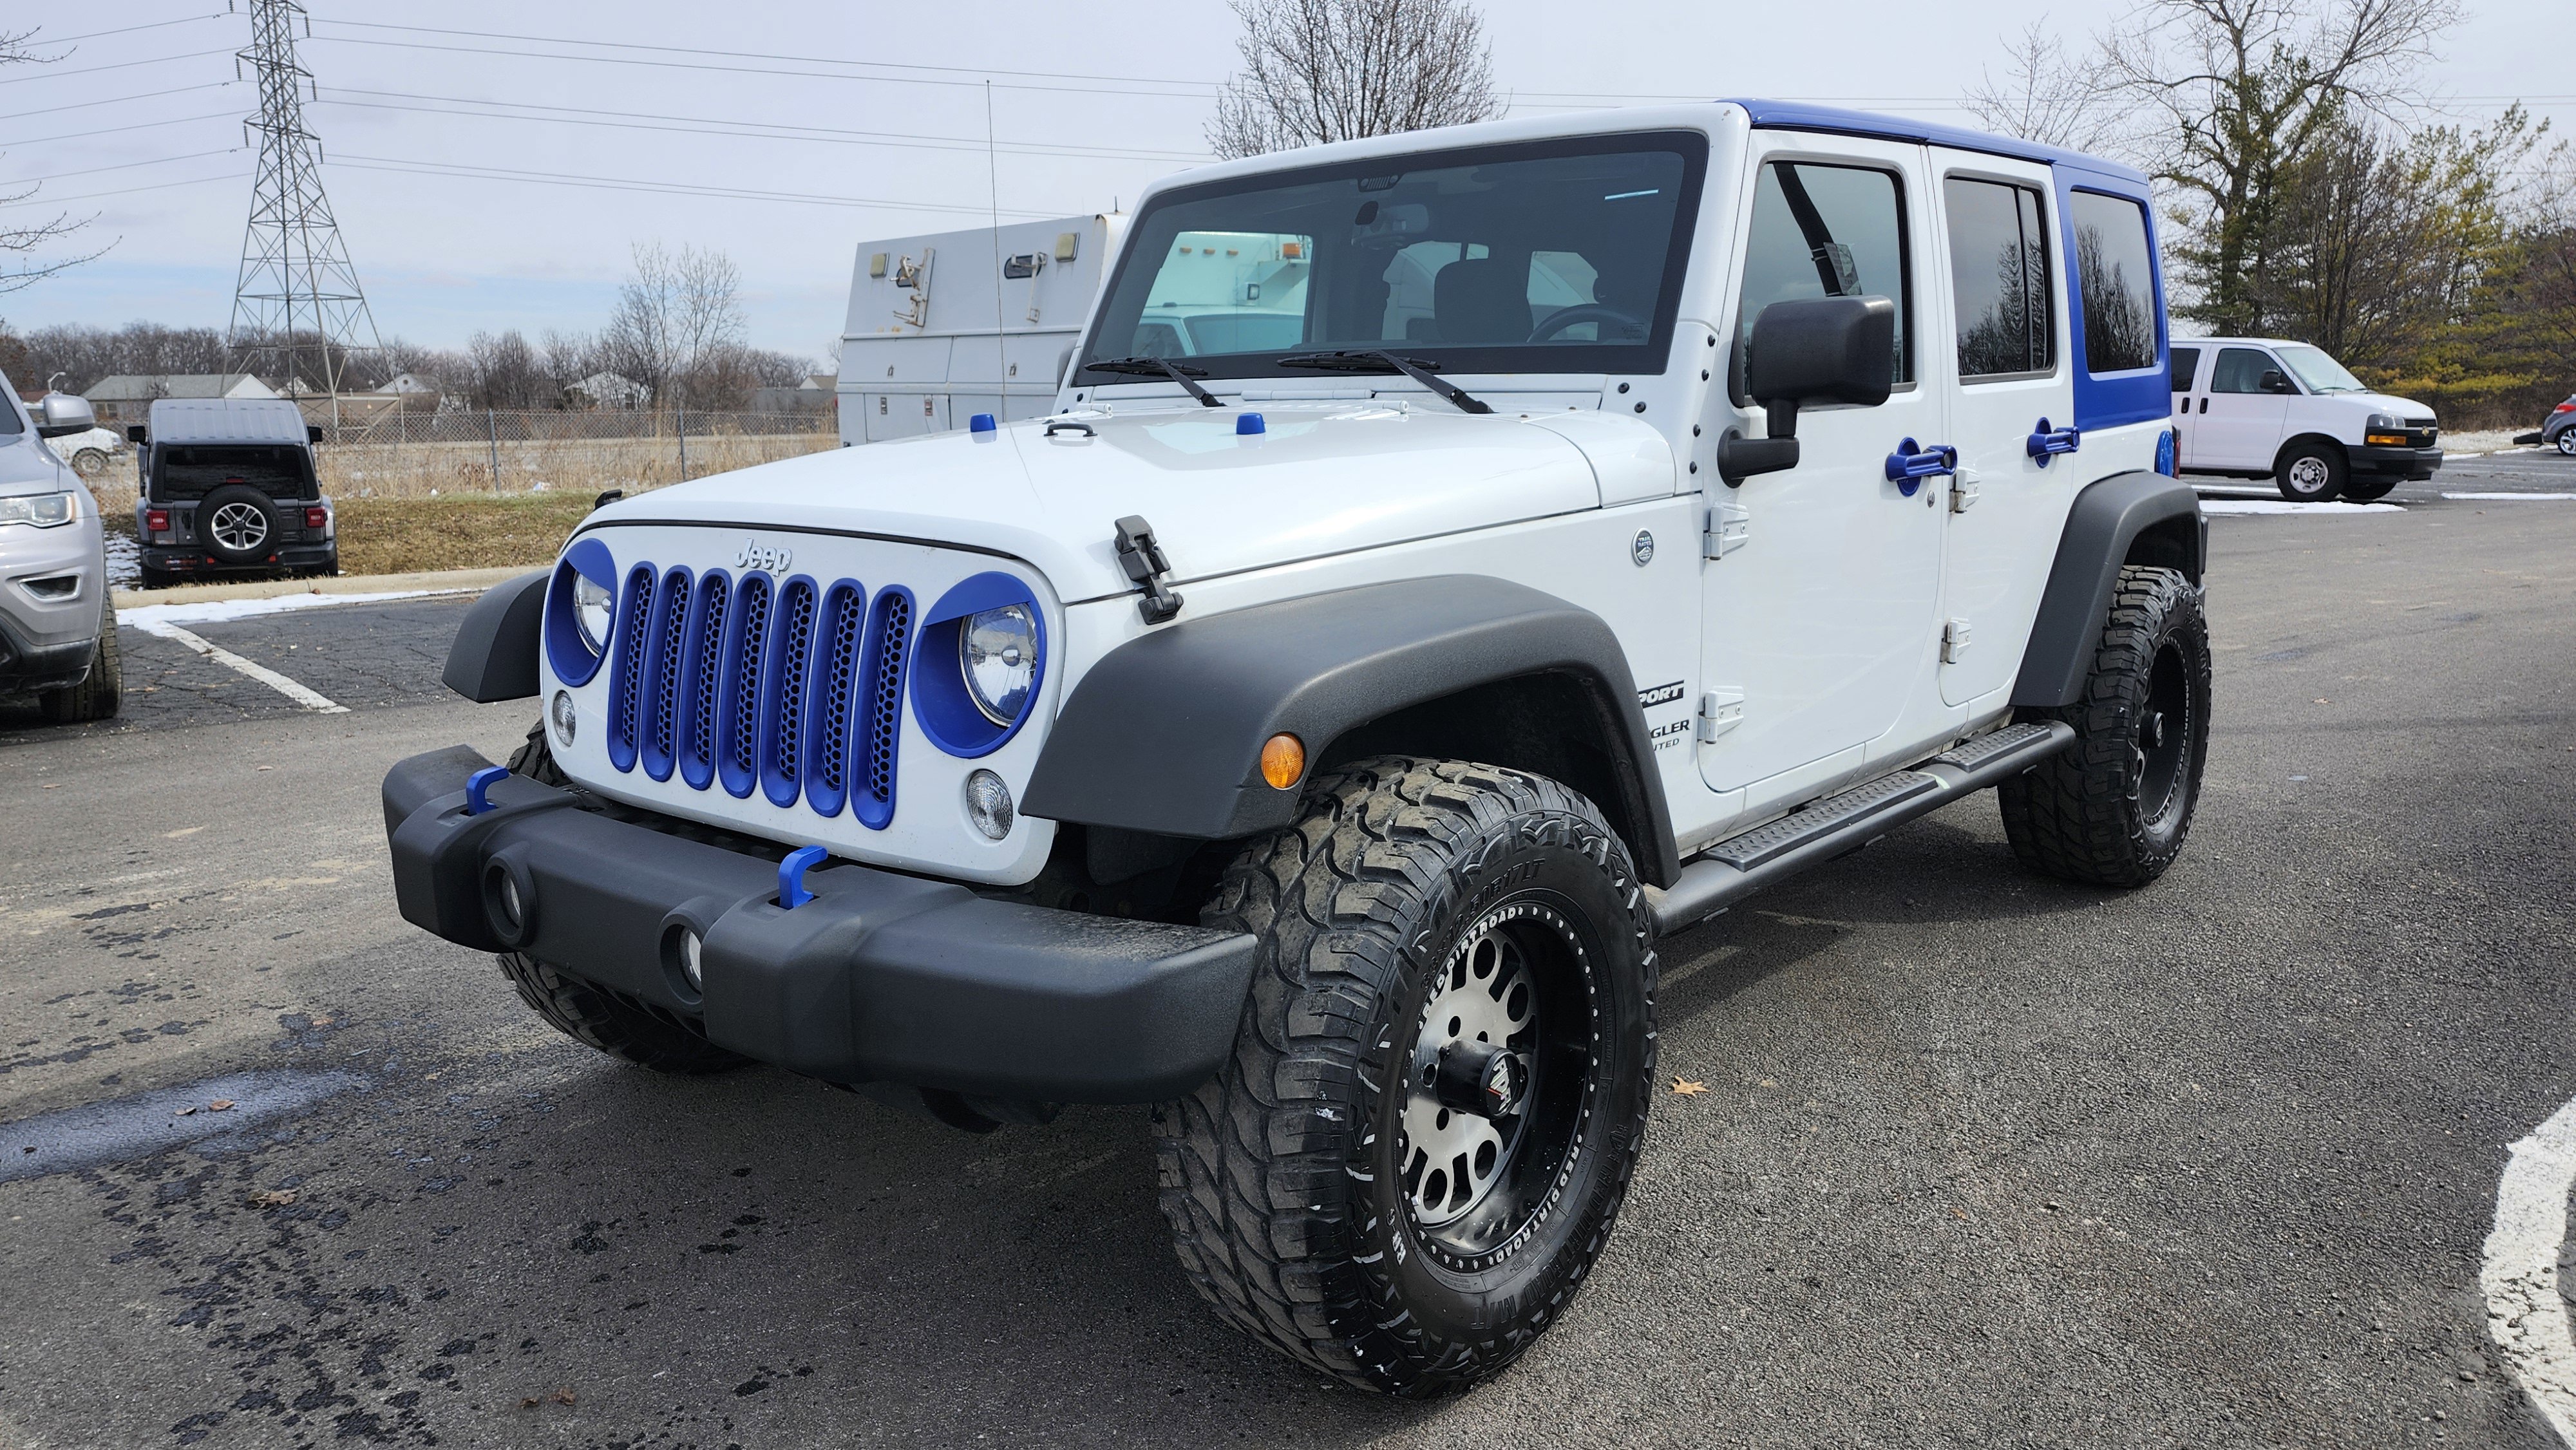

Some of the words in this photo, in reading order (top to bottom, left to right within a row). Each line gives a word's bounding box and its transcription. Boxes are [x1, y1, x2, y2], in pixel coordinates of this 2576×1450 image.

[734, 538, 793, 577] Jeep
[1638, 683, 1685, 704] PORT
[1649, 719, 1690, 739] GLER
[1654, 738, 1680, 751] ITED
[1422, 973, 1445, 1019] RED
[1446, 929, 1477, 973] DIRT
[1479, 907, 1517, 935] ROAD
[1559, 1145, 1580, 1187] RED
[1589, 1164, 1615, 1211] RED
[1533, 1189, 1560, 1232] DIRT
[1496, 1227, 1531, 1263] ROAD
[1558, 1209, 1595, 1264] DIRT
[1524, 1252, 1565, 1307] ROAD
